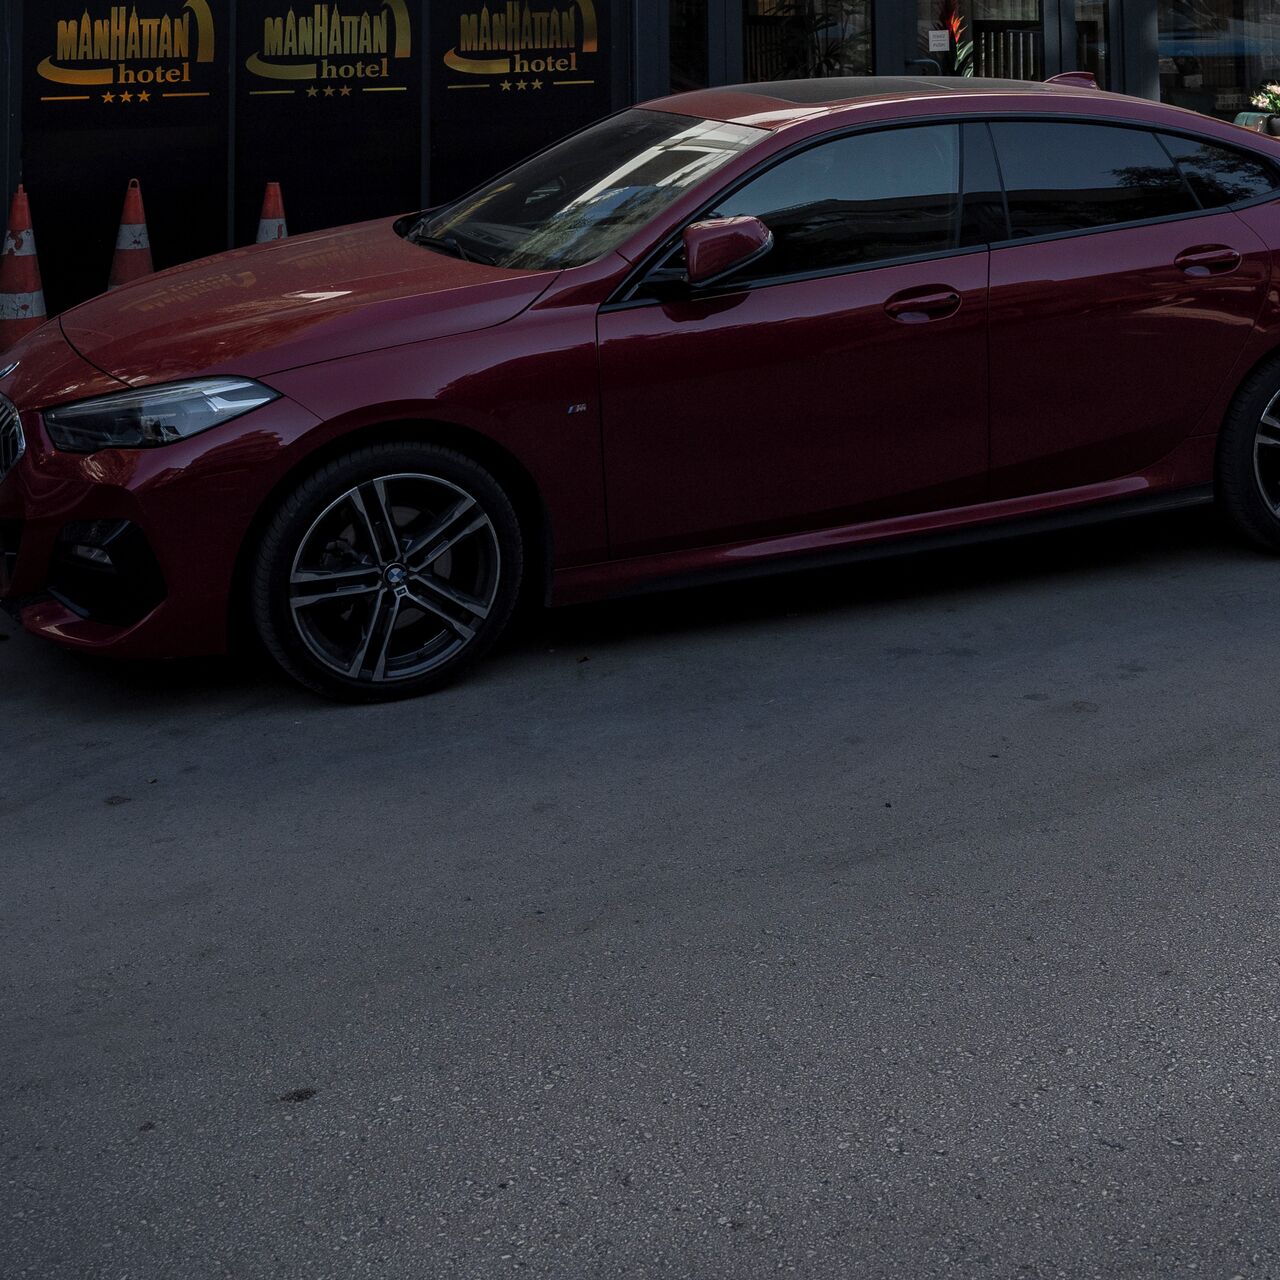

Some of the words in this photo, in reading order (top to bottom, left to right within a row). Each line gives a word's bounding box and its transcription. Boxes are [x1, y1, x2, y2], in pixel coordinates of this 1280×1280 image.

[56, 2, 190, 61] MANHATTAN
[263, 3, 388, 57] MANHATTAN
[459, 0, 576, 52] MANHATTAN
[117, 62, 191, 84] hotel
[320, 57, 390, 79] hotel
[513, 52, 578, 73] hotel
